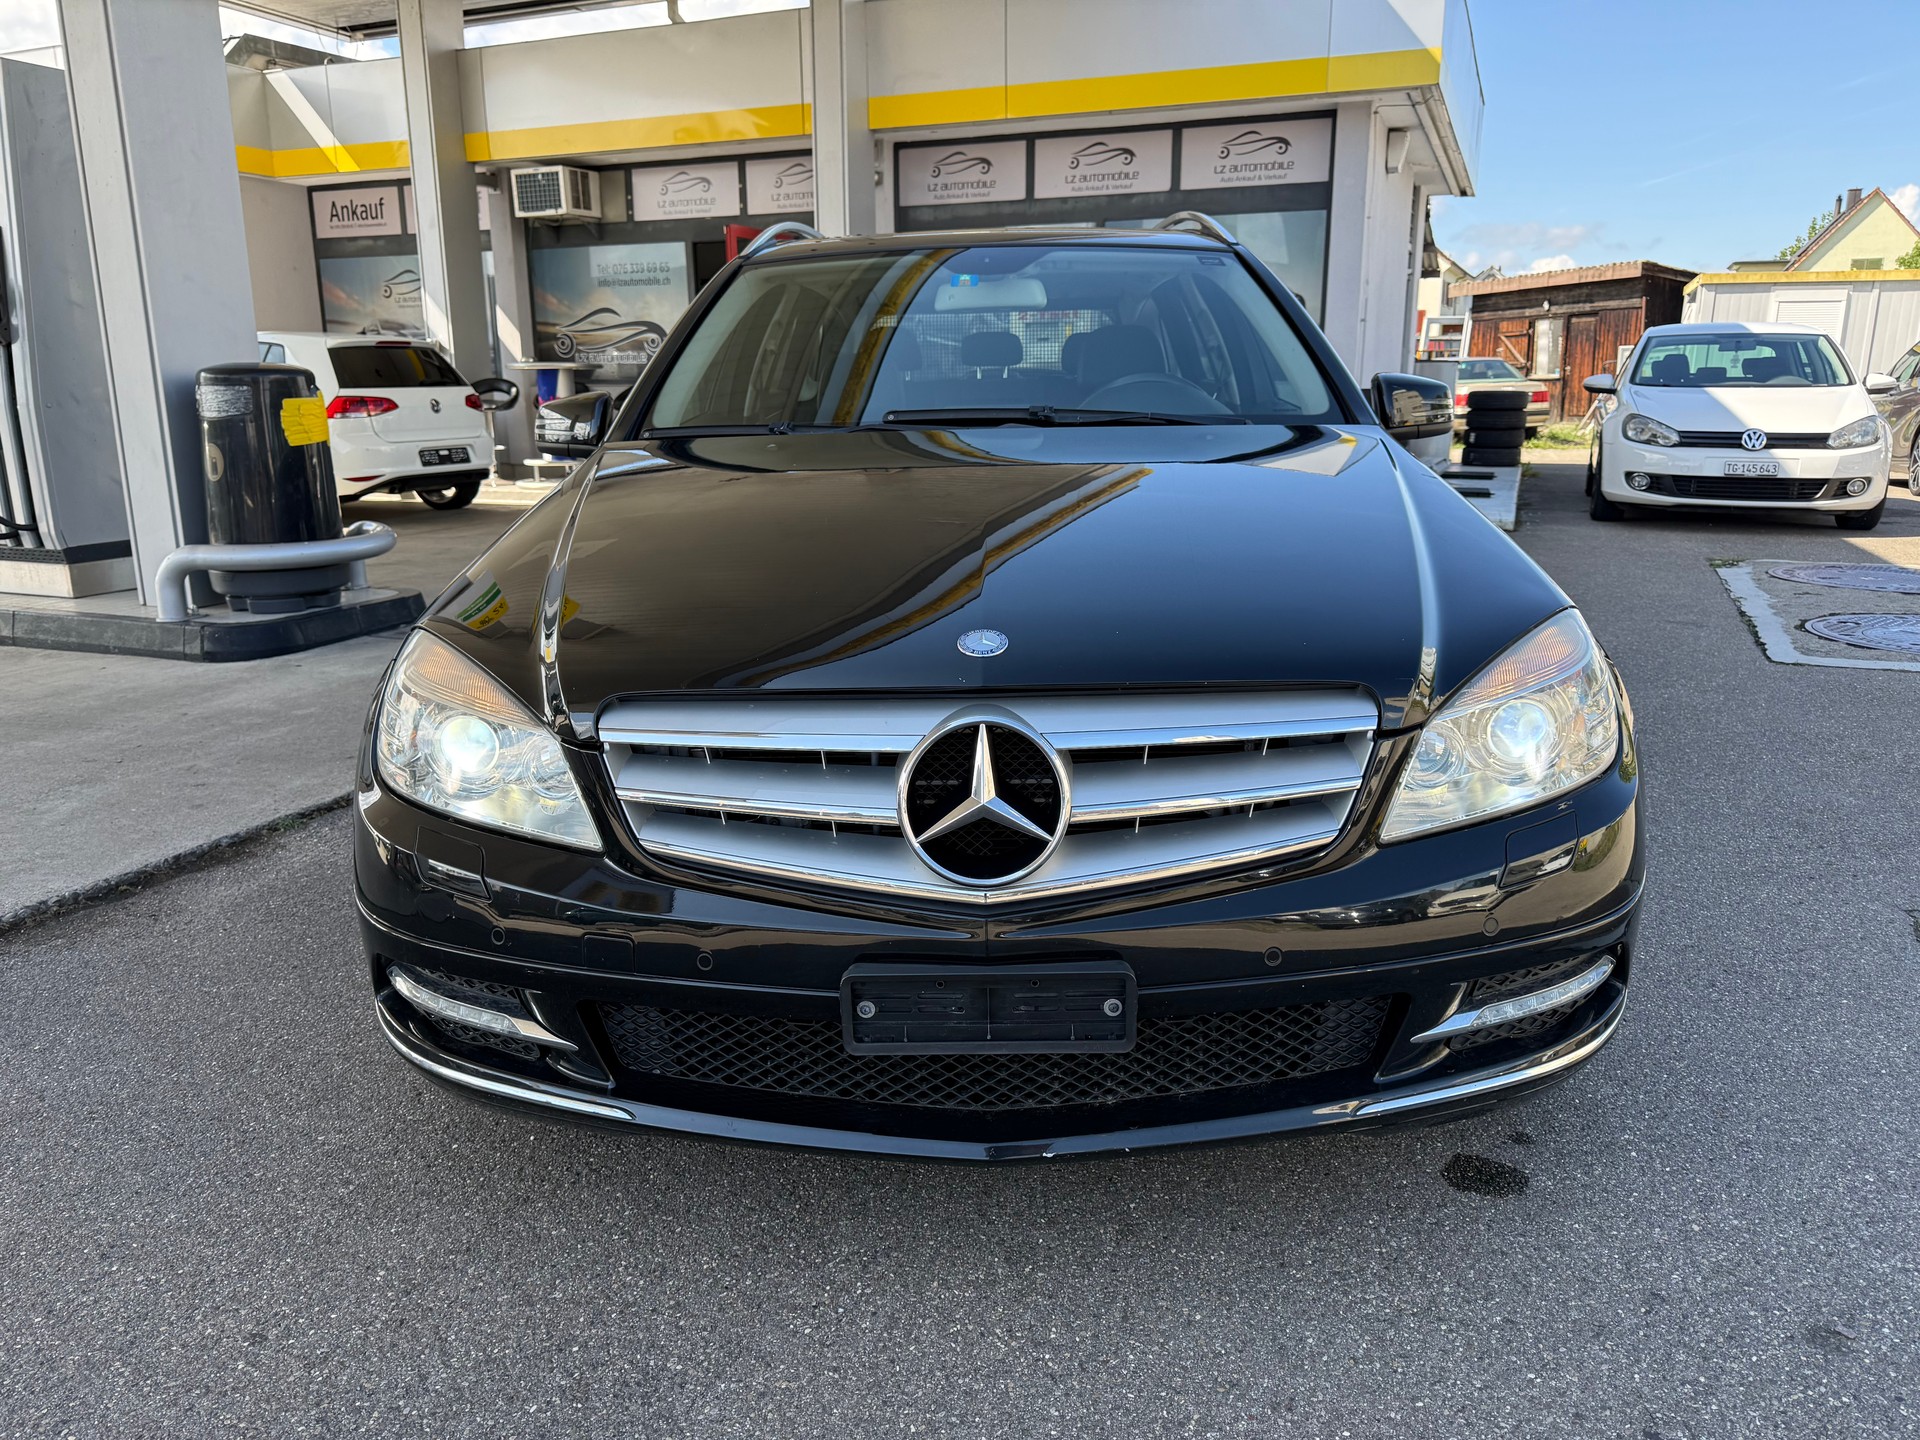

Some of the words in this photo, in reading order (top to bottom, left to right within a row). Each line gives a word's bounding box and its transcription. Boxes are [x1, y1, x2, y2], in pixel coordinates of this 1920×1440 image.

[1213, 165, 1227, 174] LZ
[1065, 174, 1077, 184] LZ
[927, 183, 938, 192] LZ
[771, 193, 781, 202] LZ
[657, 200, 667, 208] LZ
[330, 197, 385, 222] Ankauf
[612, 263, 629, 274] 076
[630, 262, 645, 274] 339
[646, 262, 658, 273] 69
[659, 261, 670, 273] 65
